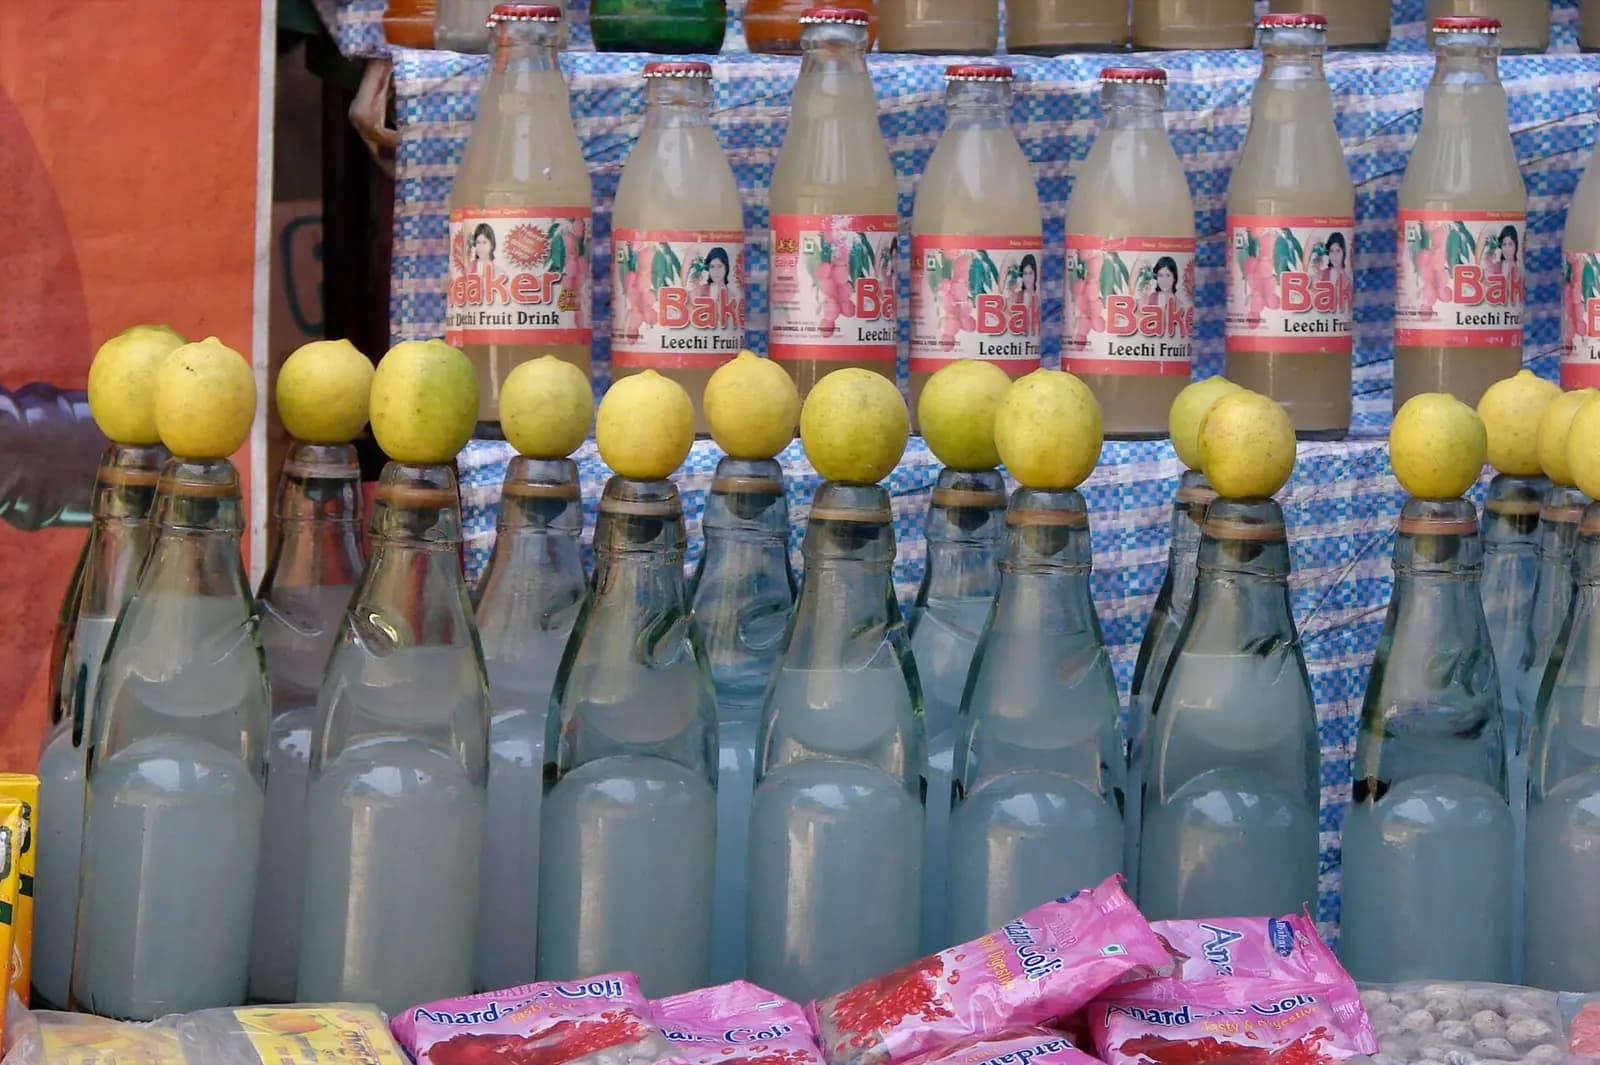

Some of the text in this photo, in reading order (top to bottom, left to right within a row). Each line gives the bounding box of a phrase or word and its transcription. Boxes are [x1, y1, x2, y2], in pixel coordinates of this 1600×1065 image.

[479, 311, 512, 325] Fruit
[517, 311, 560, 326] Drink
[1284, 318, 1329, 333] Leechi
[1456, 312, 1500, 326] Leechi
[661, 335, 707, 349] Leechi
[979, 340, 1022, 356] Leechi
[1108, 342, 1155, 357] Leechi
